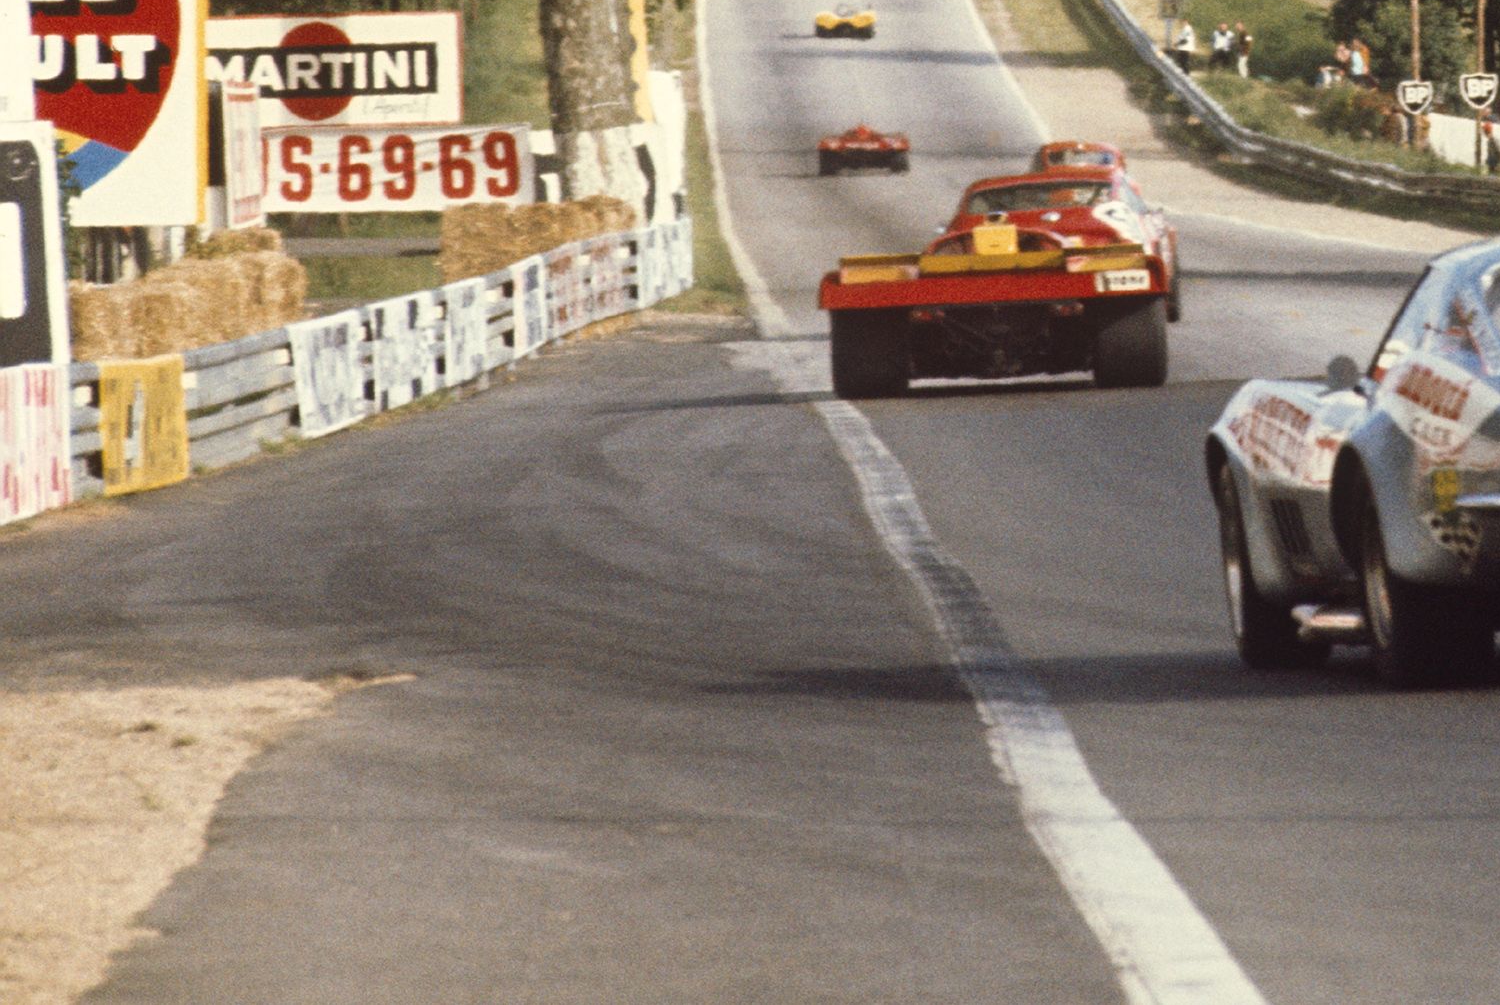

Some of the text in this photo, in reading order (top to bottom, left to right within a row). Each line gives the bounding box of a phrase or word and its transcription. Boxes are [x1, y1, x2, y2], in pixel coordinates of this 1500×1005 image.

[205, 50, 429, 90] MARTINI
[1404, 86, 1430, 104] BP
[1467, 78, 1495, 99] BP
